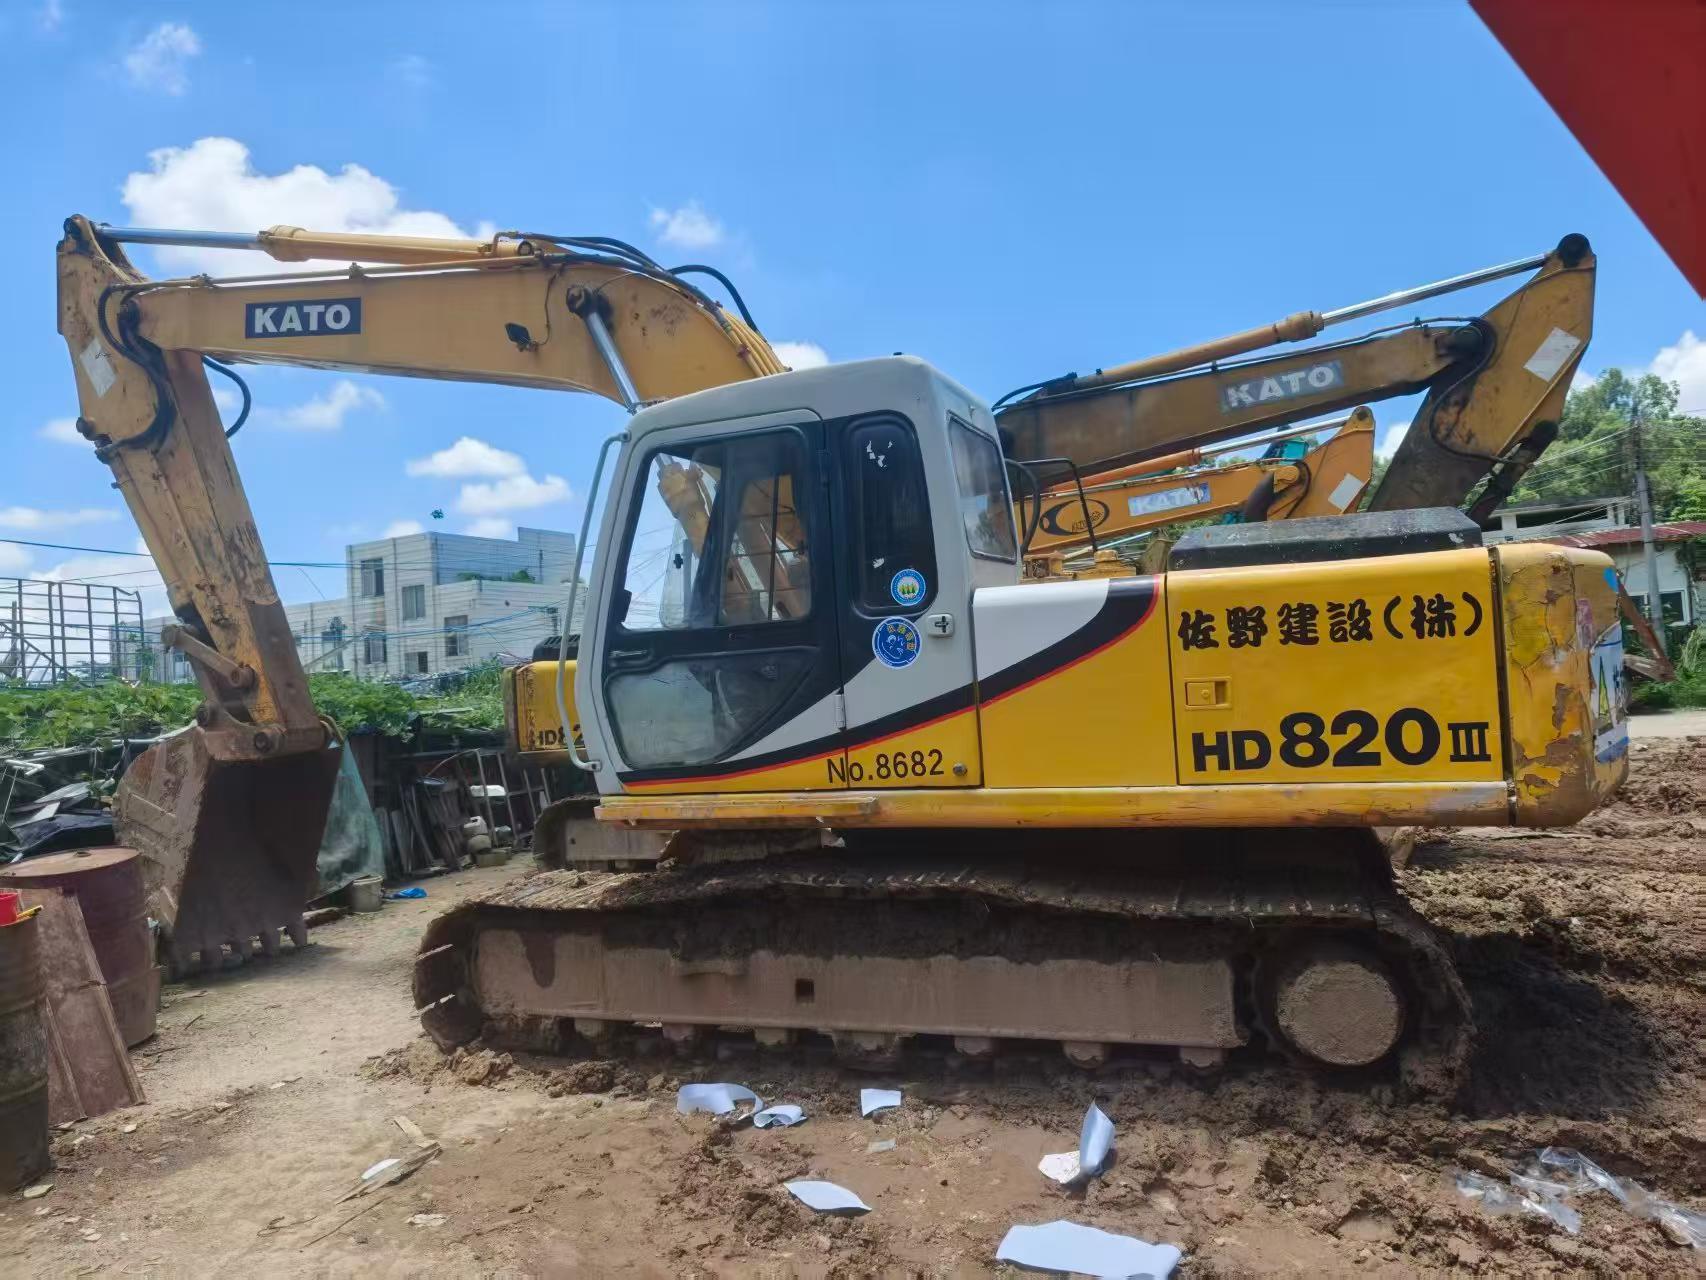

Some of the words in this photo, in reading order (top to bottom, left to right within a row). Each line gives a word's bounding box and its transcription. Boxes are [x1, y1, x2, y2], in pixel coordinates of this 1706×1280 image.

[254, 304, 351, 333] KATO
[1227, 366, 1335, 407] KATO
[826, 748, 945, 783] No.8682
